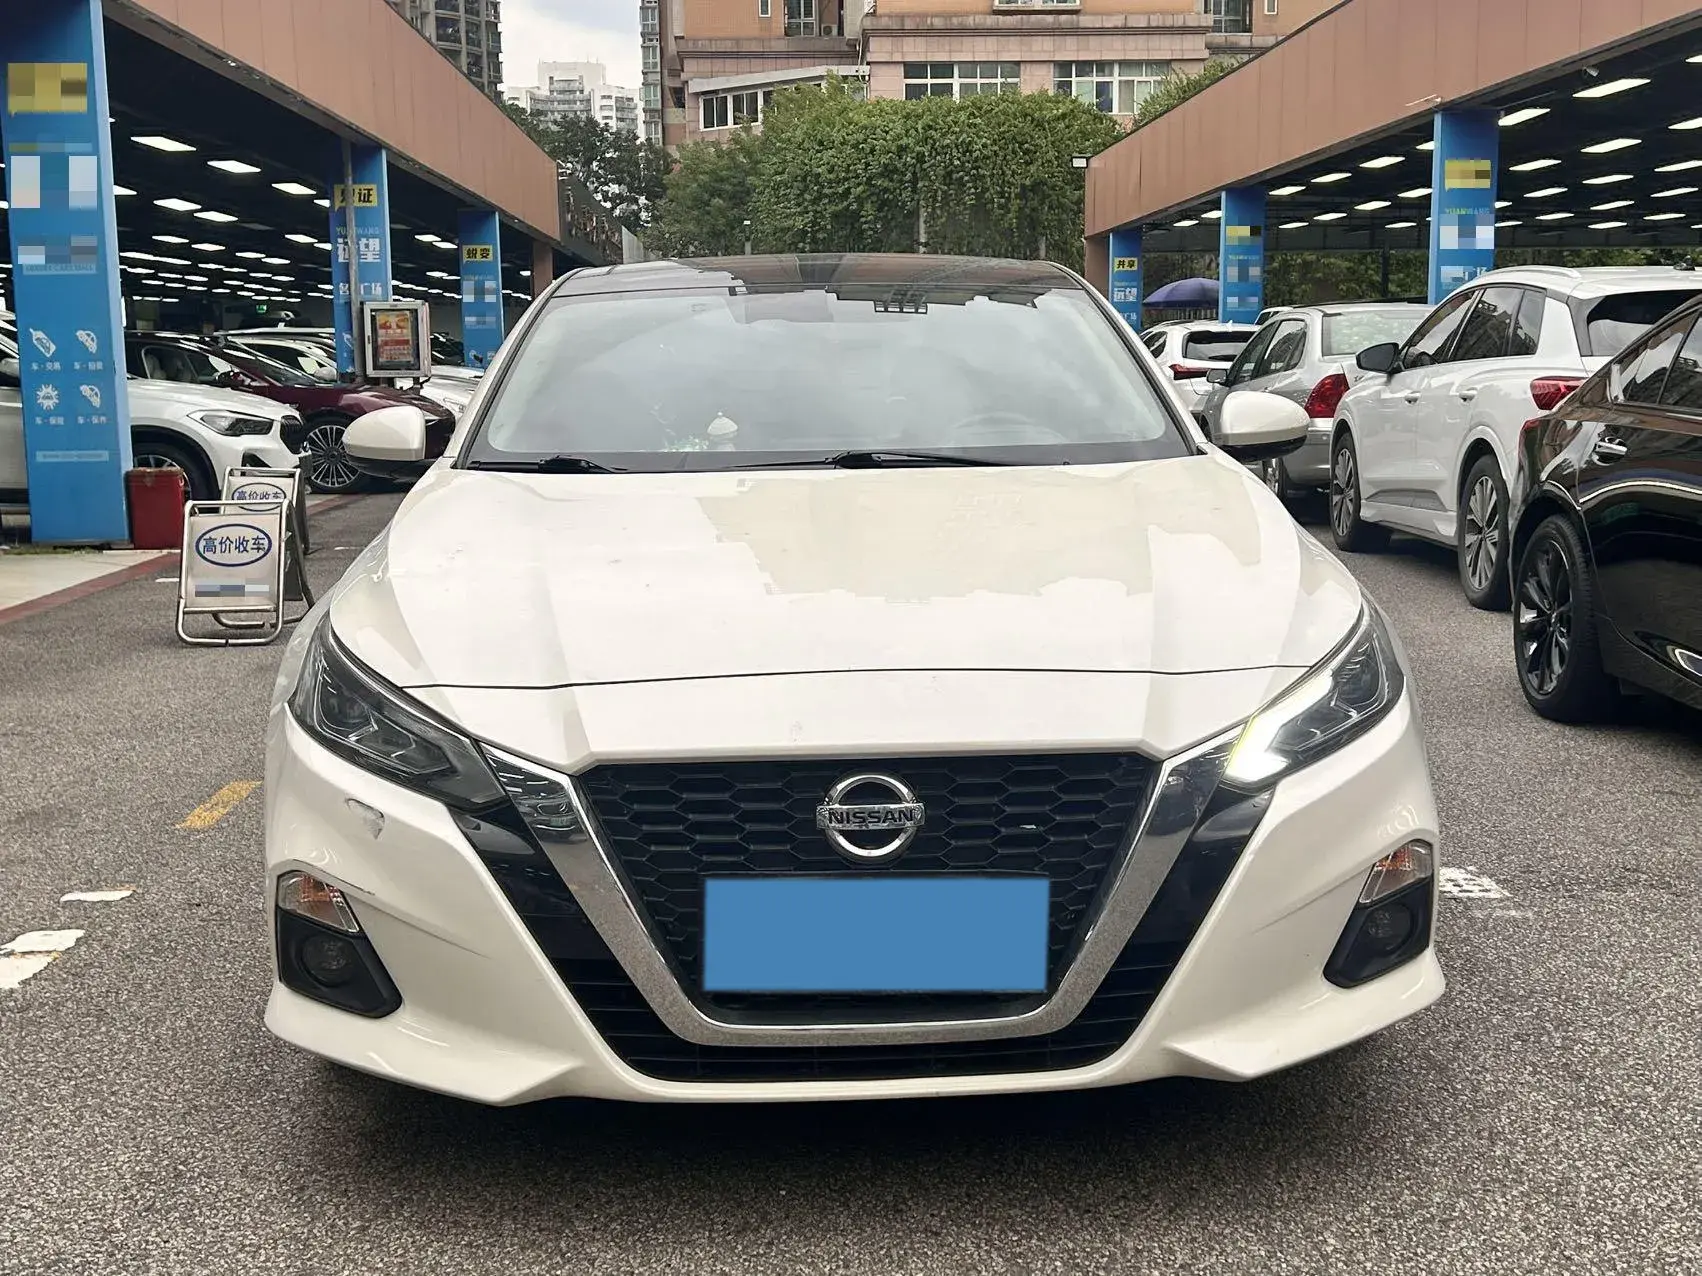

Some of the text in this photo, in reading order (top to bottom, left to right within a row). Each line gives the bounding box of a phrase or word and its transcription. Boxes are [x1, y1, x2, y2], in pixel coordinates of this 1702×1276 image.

[1116, 259, 1136, 269] 共享
[339, 282, 382, 295] 名广场
[236, 490, 283, 500] 高价收车
[202, 536, 266, 555] 高价收车
[827, 809, 913, 825] NISSAN
